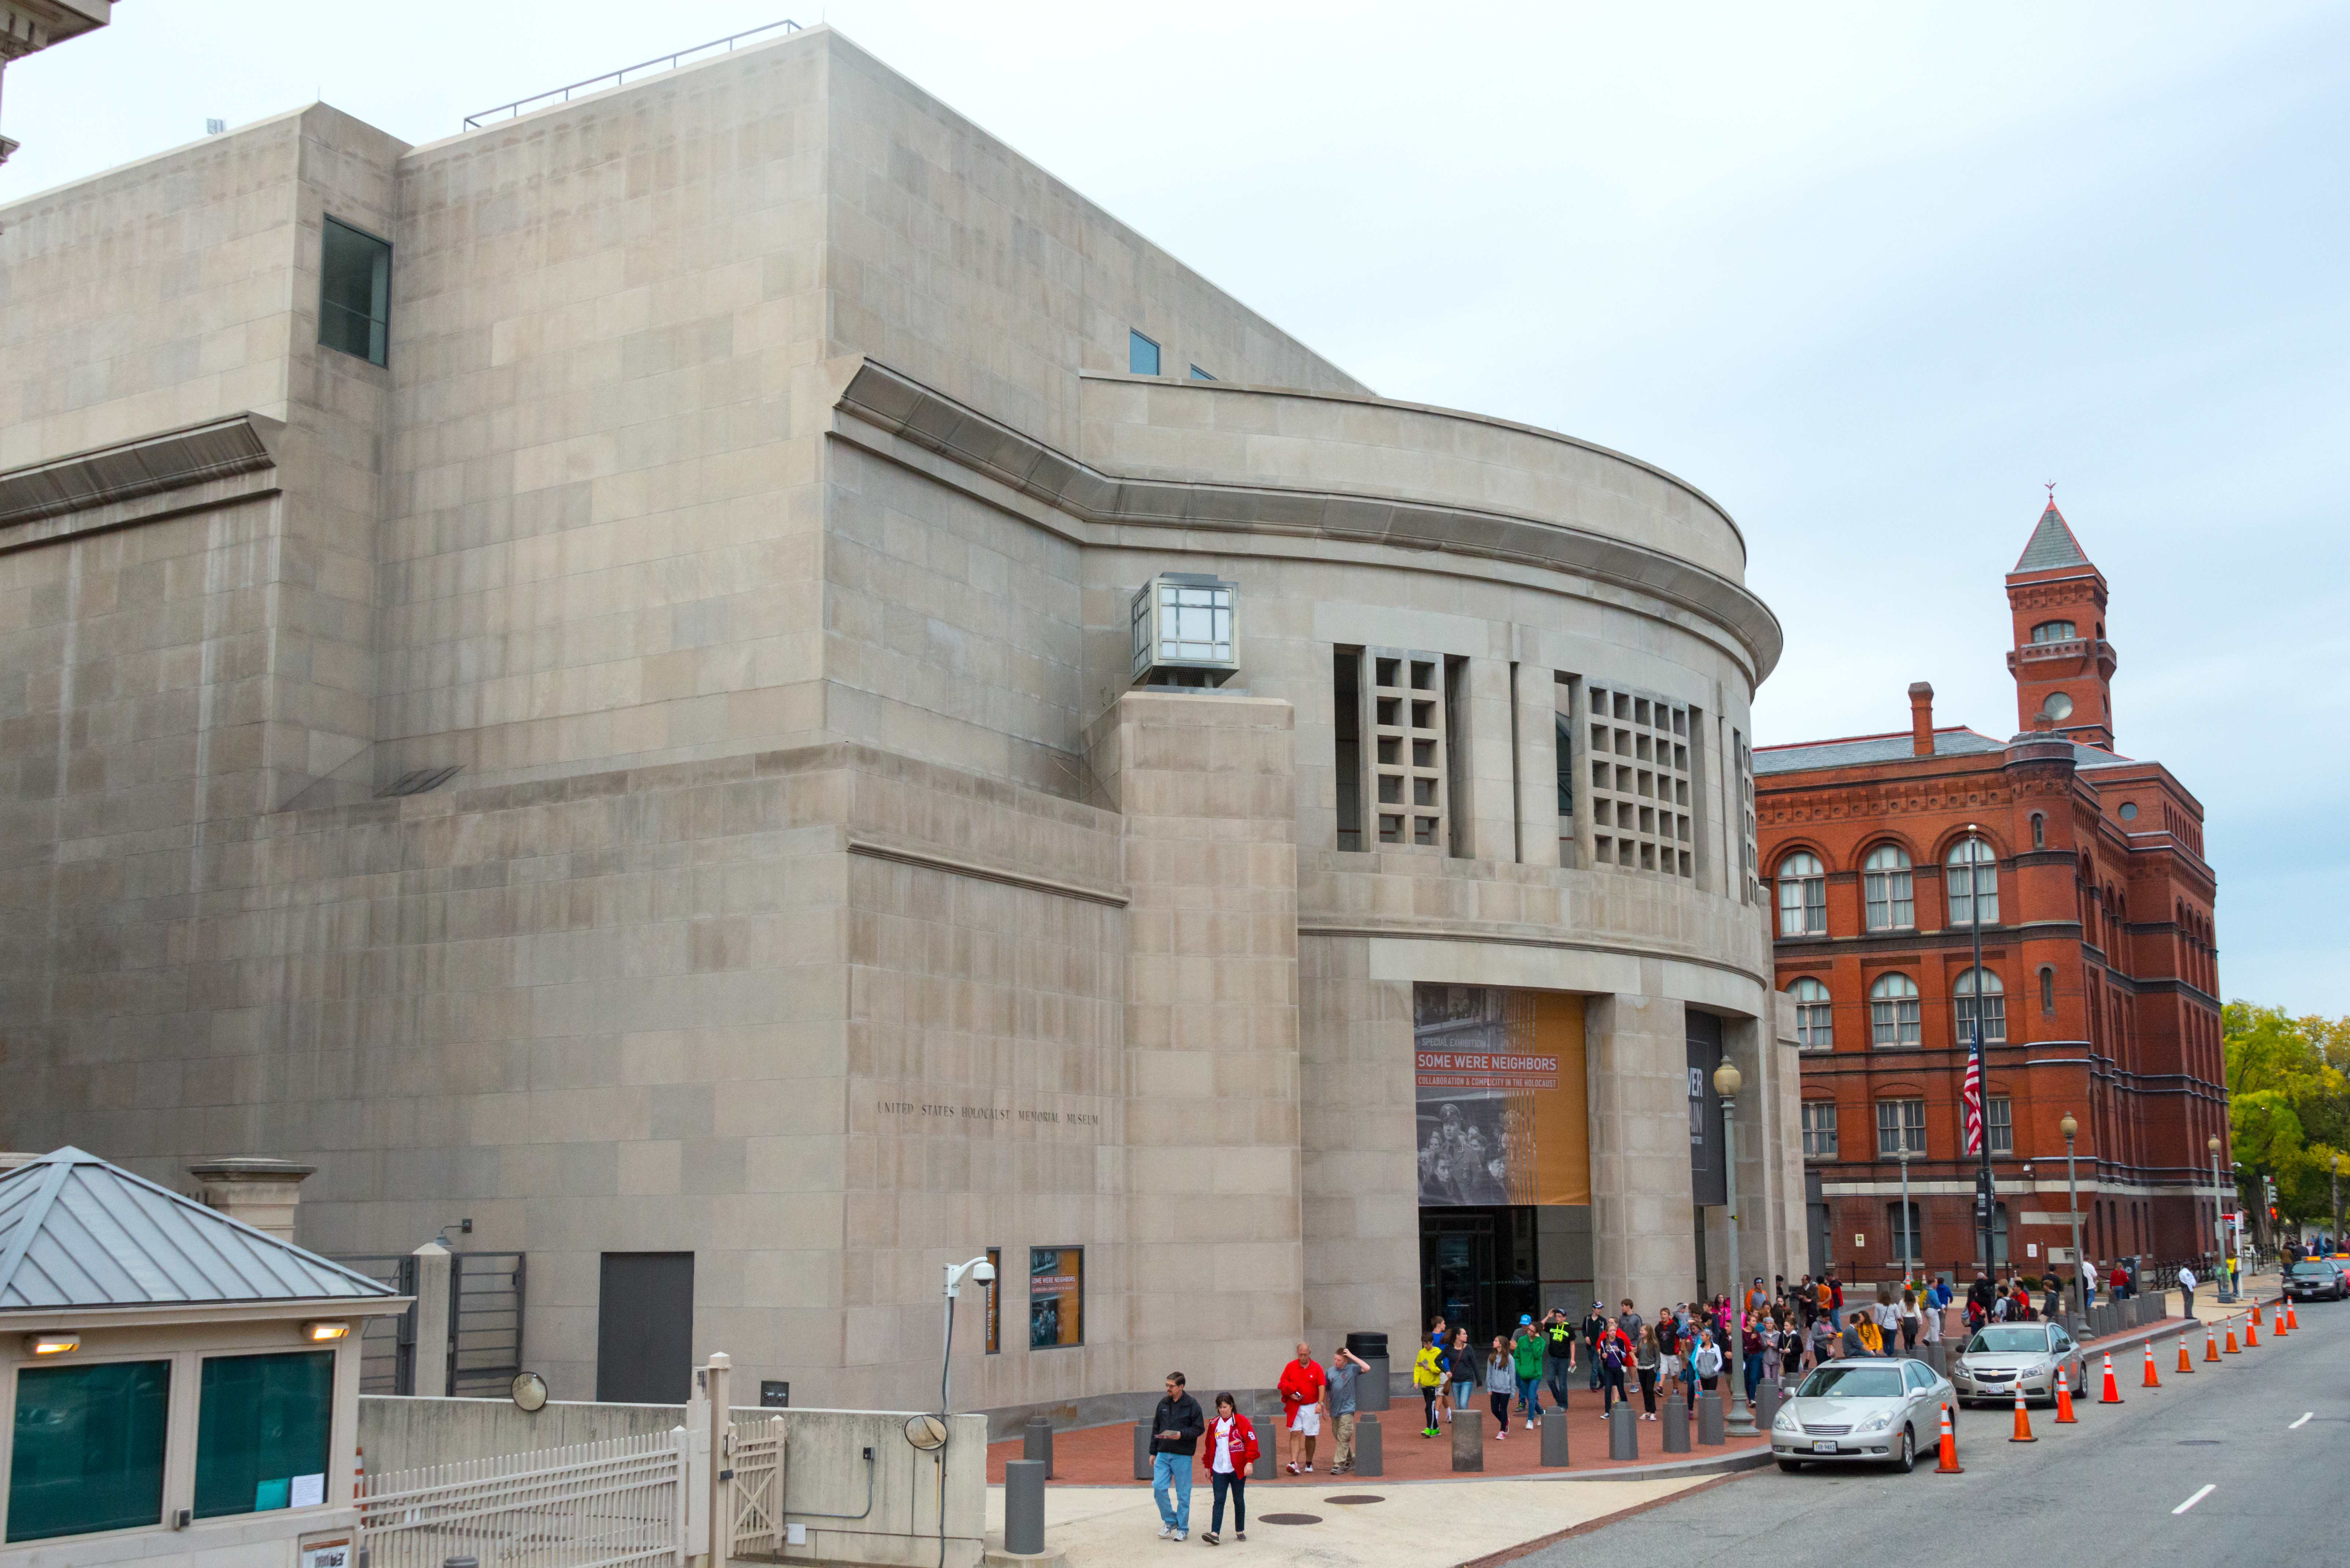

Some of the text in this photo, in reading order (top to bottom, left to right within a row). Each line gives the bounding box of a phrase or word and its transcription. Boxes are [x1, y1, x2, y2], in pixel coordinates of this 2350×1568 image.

[1422, 1038, 1486, 1047] SPECIAL EXHIBITION
[1418, 1054, 1556, 1070] SOME WERE NEIGHBORS
[1418, 1077, 1464, 1085] COLLABORATION
[1472, 1078, 1503, 1086] COMPLICITY
[1524, 1079, 1556, 1087] HOLOCAUST
[878, 1102, 1098, 1125] UNITED STATES HOLOCAUST MEMORIAL MUSEUM
